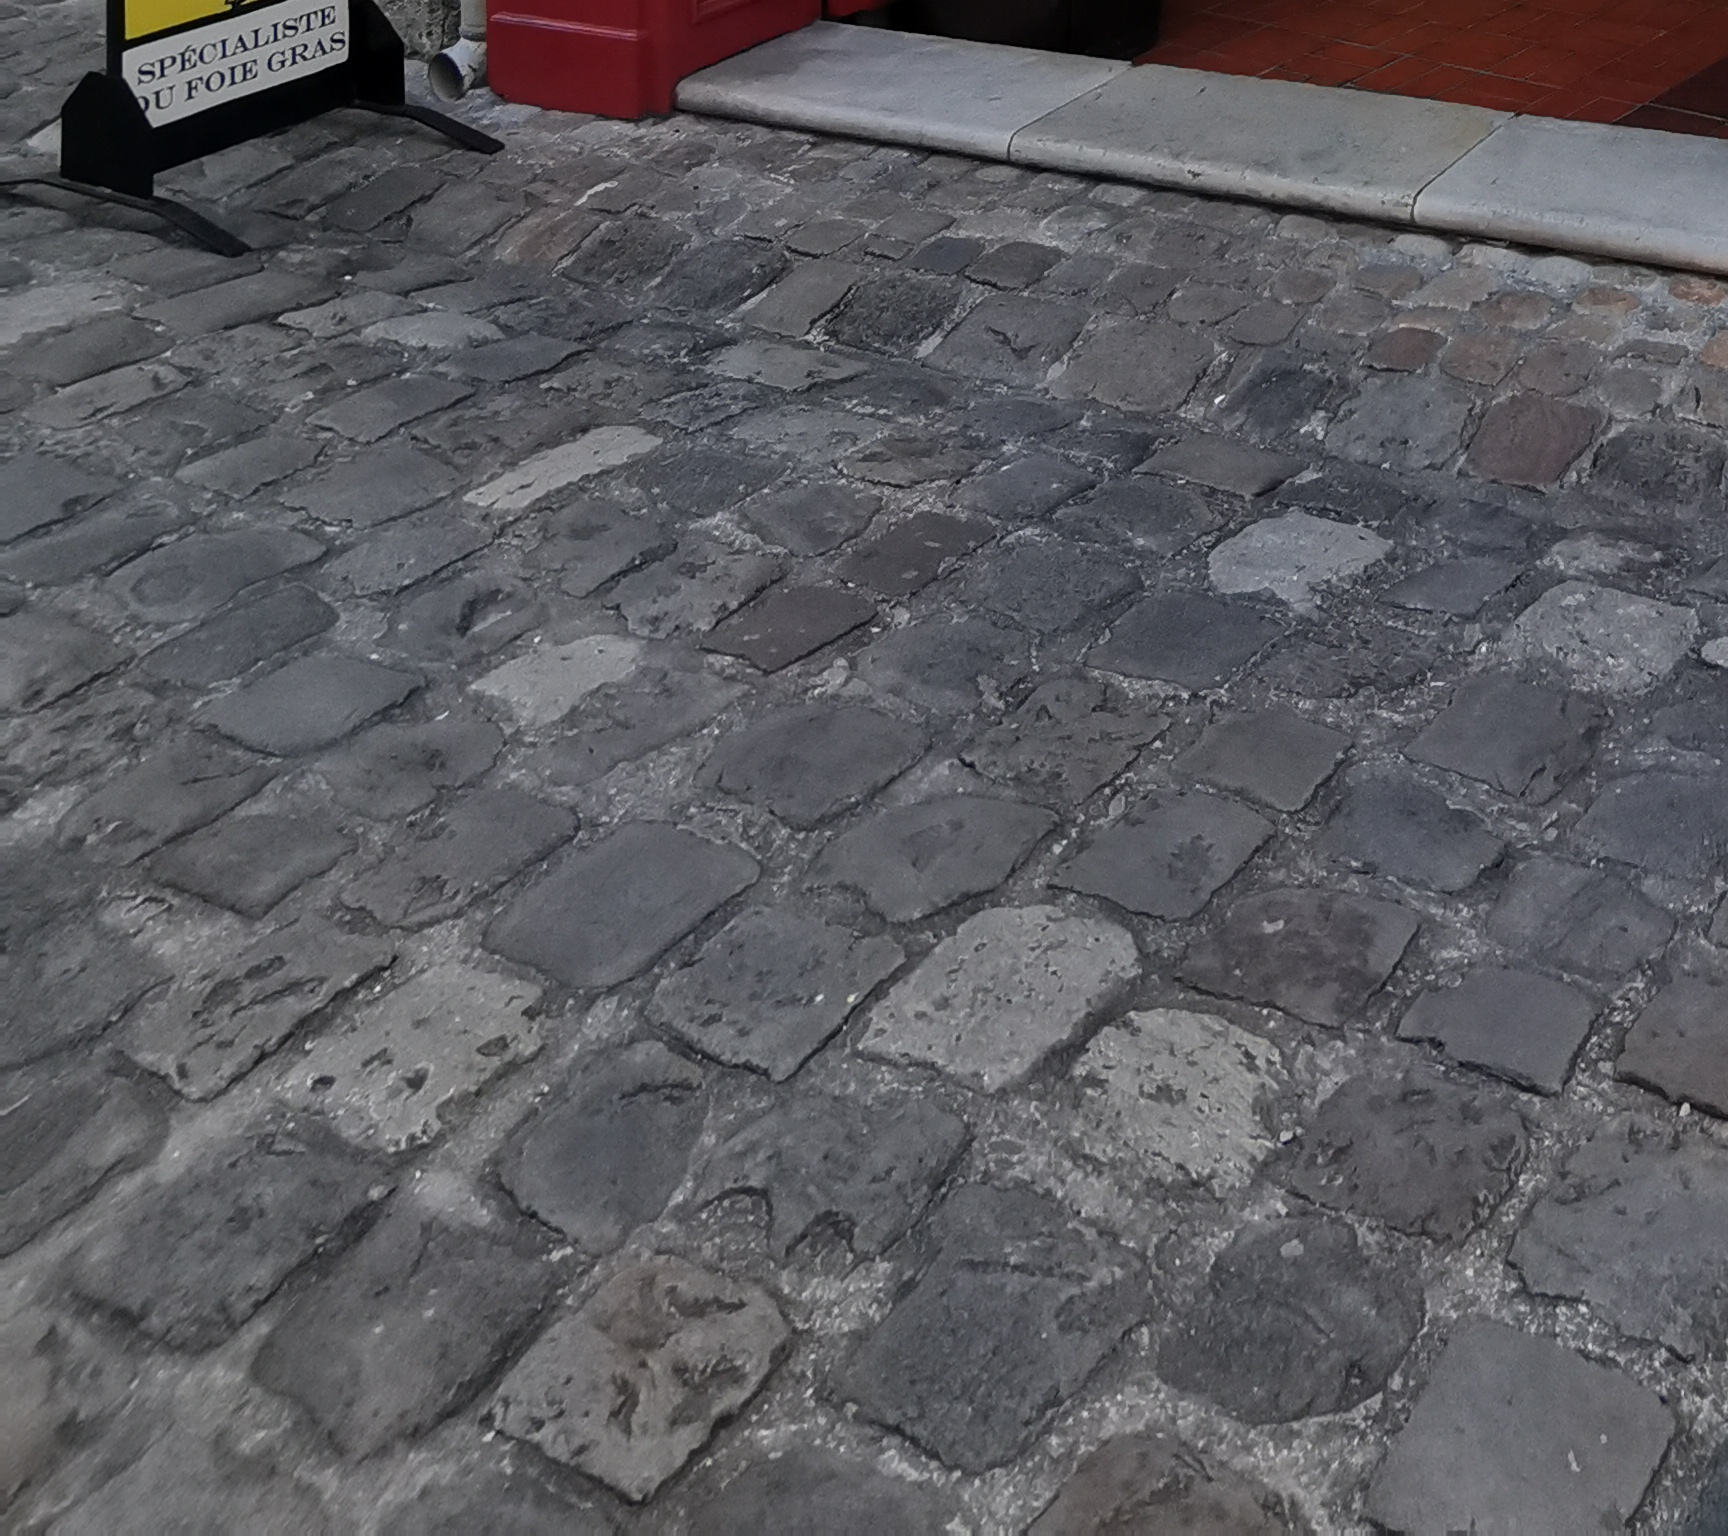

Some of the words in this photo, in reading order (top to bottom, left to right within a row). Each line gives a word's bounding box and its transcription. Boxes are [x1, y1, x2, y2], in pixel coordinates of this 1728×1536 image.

[137, 5, 337, 86] SPÉCIALISTE
[183, 59, 258, 102] FOIE
[267, 31, 347, 73] GRAS
